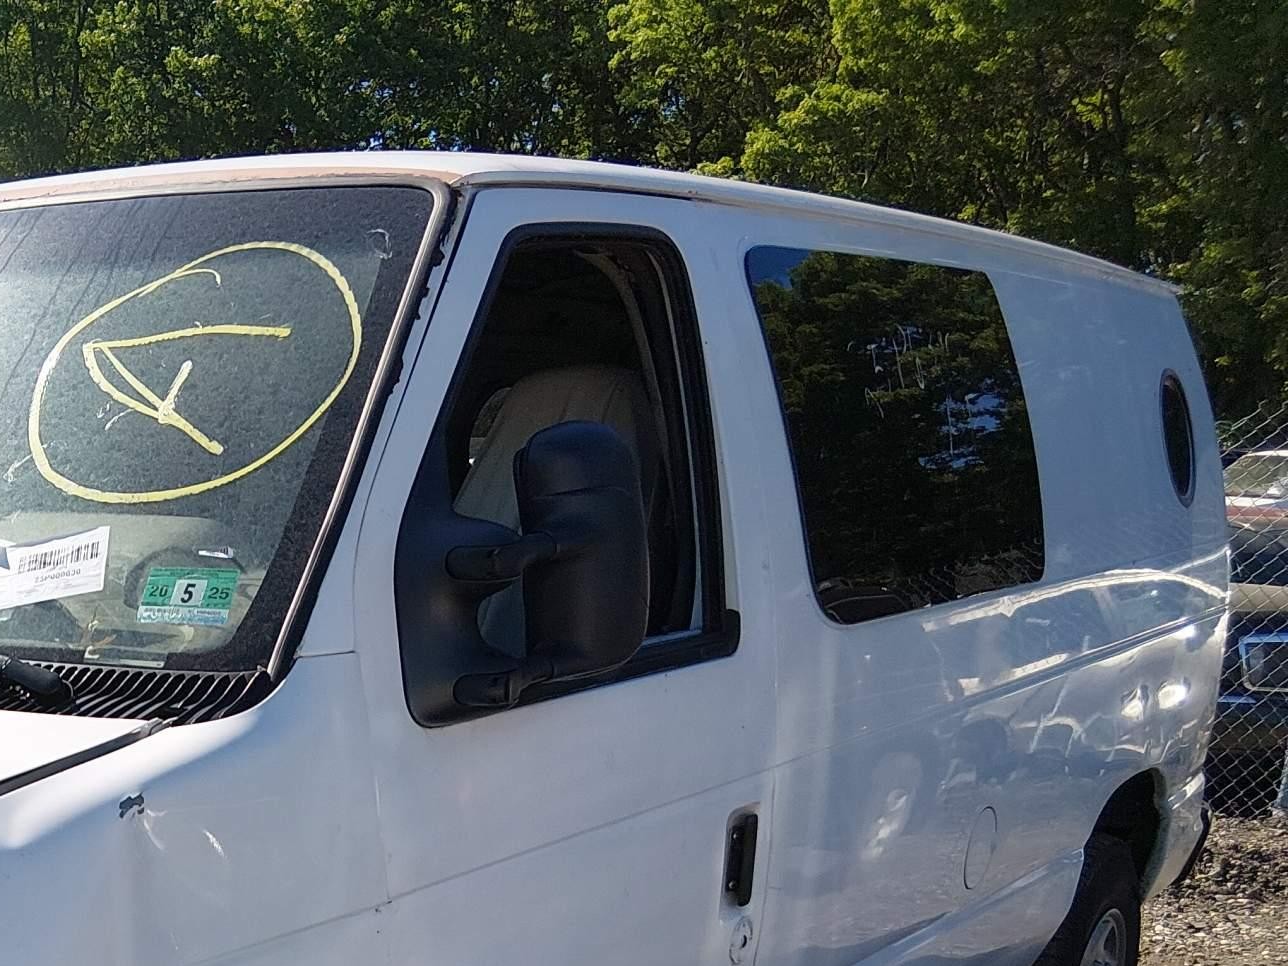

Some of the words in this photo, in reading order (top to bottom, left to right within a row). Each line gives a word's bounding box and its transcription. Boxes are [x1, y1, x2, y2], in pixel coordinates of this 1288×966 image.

[150, 585, 168, 597] 20
[180, 583, 196, 603] 5
[209, 587, 230, 600] 25
